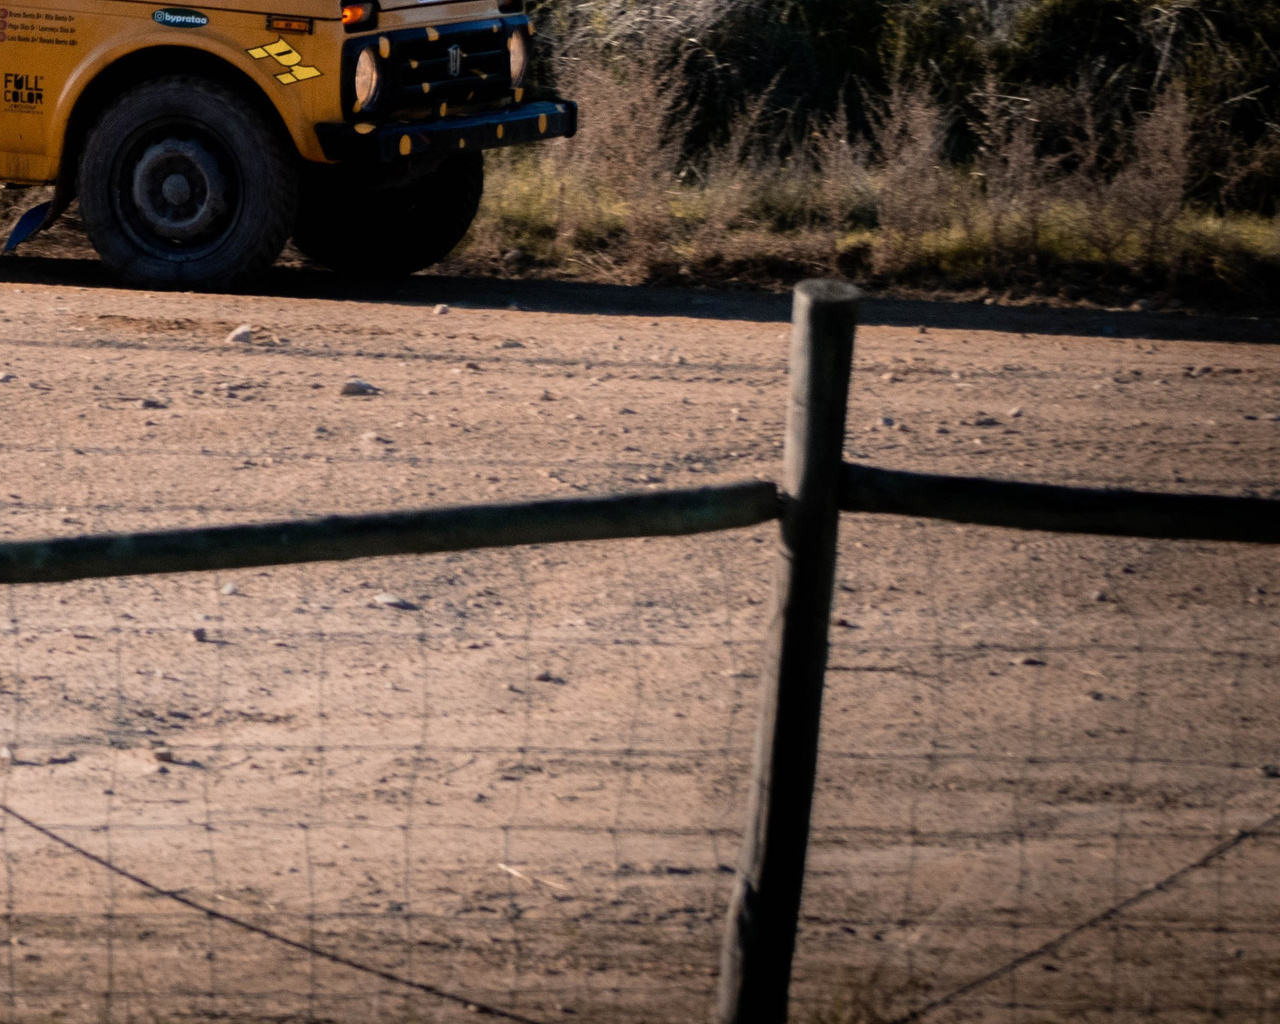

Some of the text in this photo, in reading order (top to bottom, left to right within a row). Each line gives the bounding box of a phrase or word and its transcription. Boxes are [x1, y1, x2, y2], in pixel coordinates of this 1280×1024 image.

[165, 12, 208, 24] byprataa
[4, 73, 43, 91] FULL
[4, 90, 43, 104] COLOR
